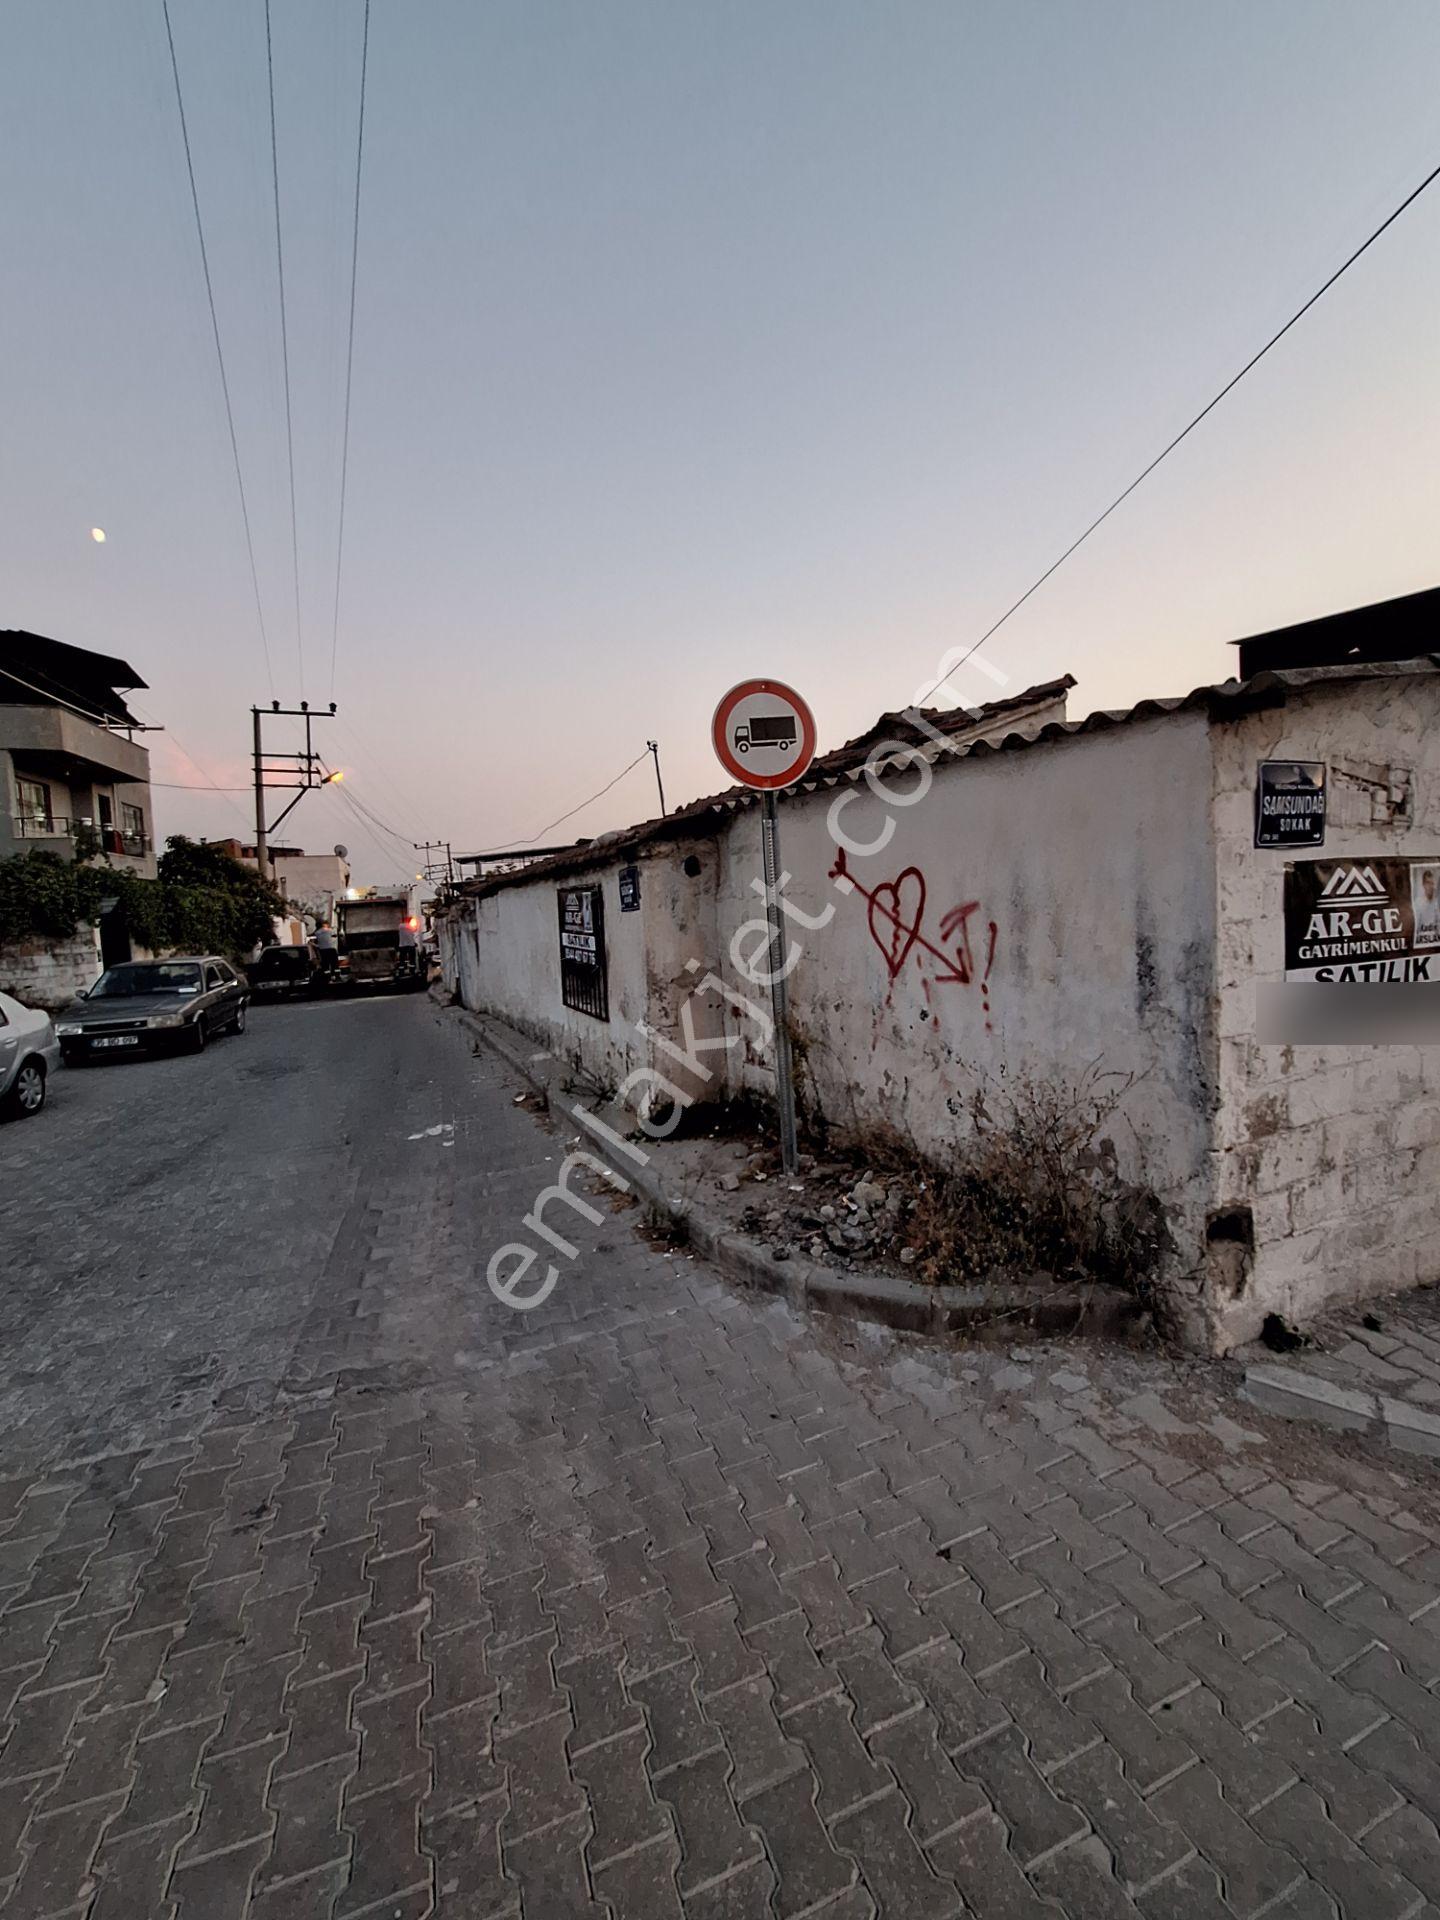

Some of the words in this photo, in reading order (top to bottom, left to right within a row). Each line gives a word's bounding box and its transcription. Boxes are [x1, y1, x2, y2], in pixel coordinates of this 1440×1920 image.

[1280, 818, 1312, 832] SOKAK
[1304, 908, 1403, 940] AR-GE
[1298, 937, 1408, 960] GAYRİMENKUL
